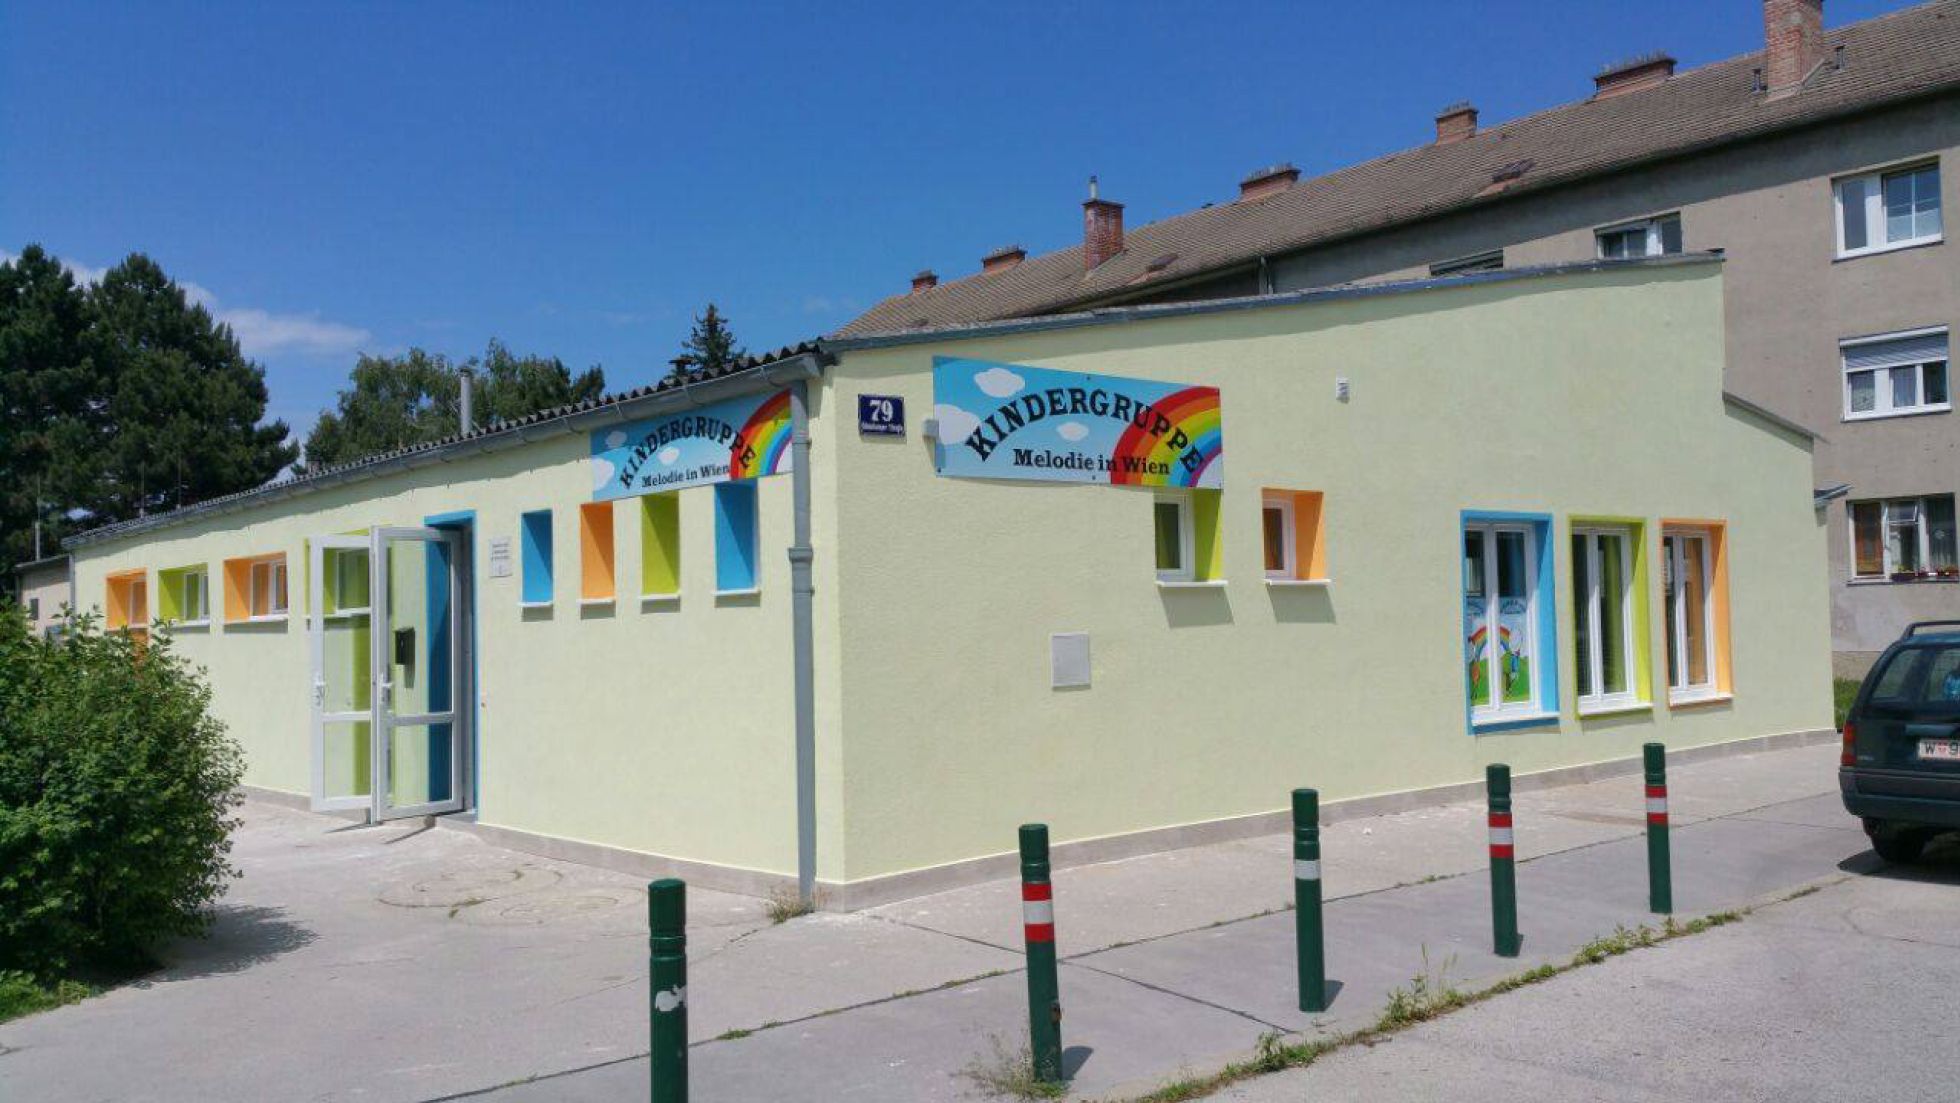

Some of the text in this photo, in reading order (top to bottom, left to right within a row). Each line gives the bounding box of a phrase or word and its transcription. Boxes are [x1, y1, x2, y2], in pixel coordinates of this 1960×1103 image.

[870, 399, 893, 421] 79
[965, 387, 1206, 473] KINDERGRUPPE
[619, 416, 757, 489] KINDERGRUPPE
[1013, 448, 1170, 474] Melodie in Wien
[641, 463, 730, 488] Melodie in Wien
